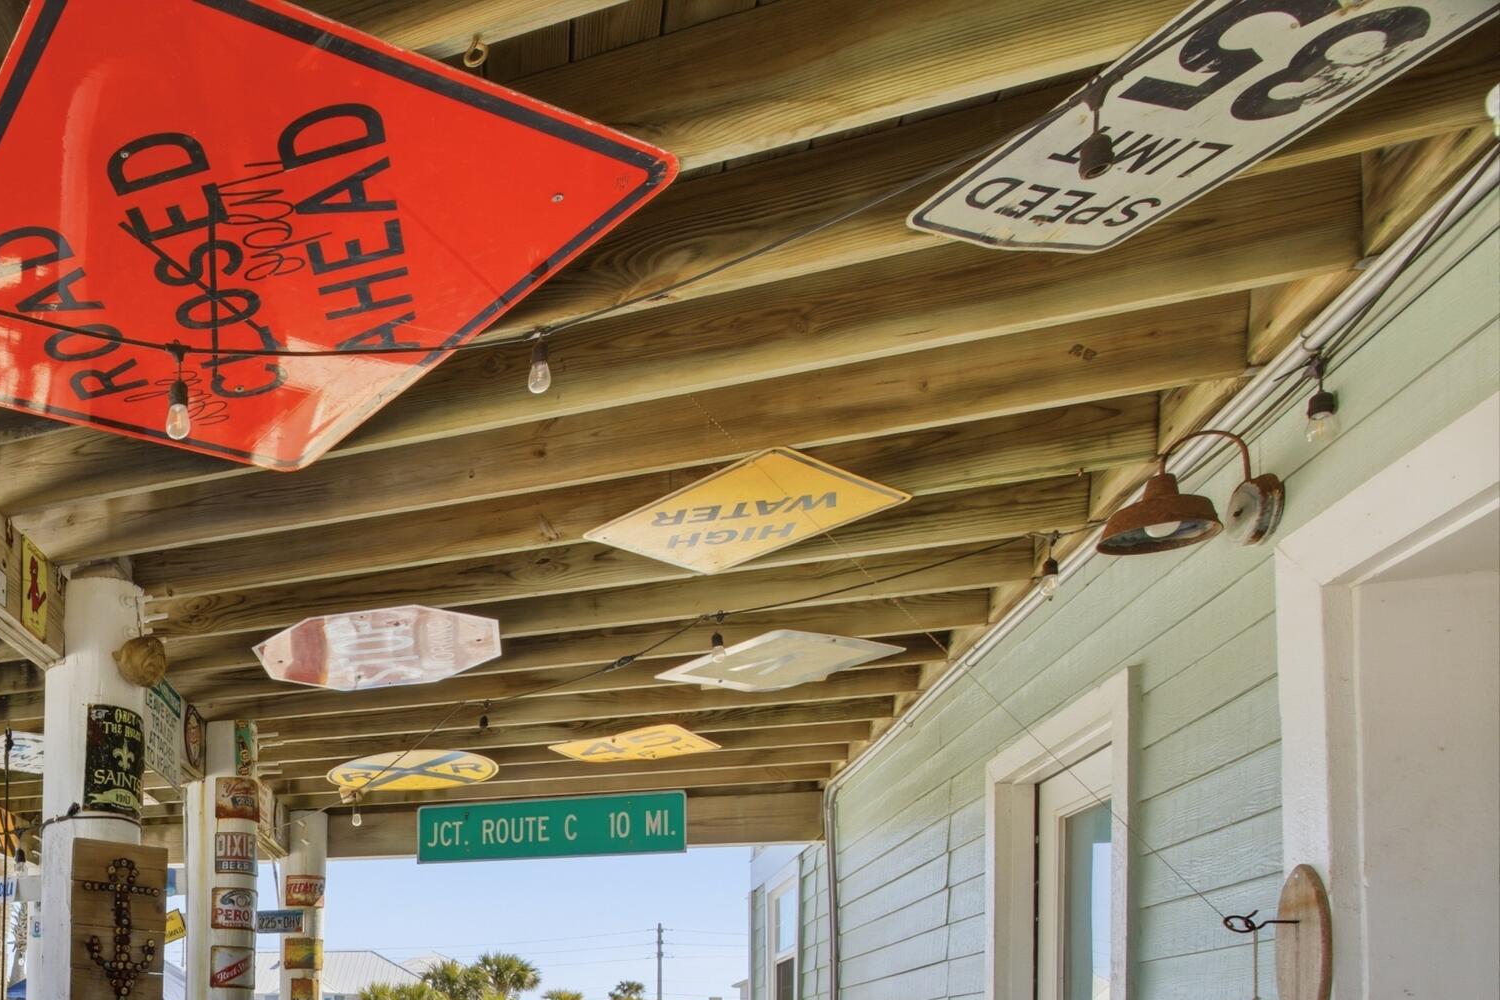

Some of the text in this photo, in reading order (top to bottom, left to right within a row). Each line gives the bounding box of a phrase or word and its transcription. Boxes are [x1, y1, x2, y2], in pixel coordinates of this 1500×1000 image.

[1120, 0, 1432, 121] 35
[1047, 125, 1235, 180] LIMIT
[964, 176, 1163, 228] SPEED
[275, 101, 423, 354] AHEAD
[105, 130, 291, 401] CLOSED
[650, 491, 838, 528] WATER
[666, 522, 798, 550] HIGH
[93, 769, 142, 793] SAINTS
[342, 760, 486, 784] R R
[216, 834, 253, 858] DIXIE
[426, 808, 677, 848] JCT. ROUTE C 10 MI.
[221, 861, 250, 871] BEER
